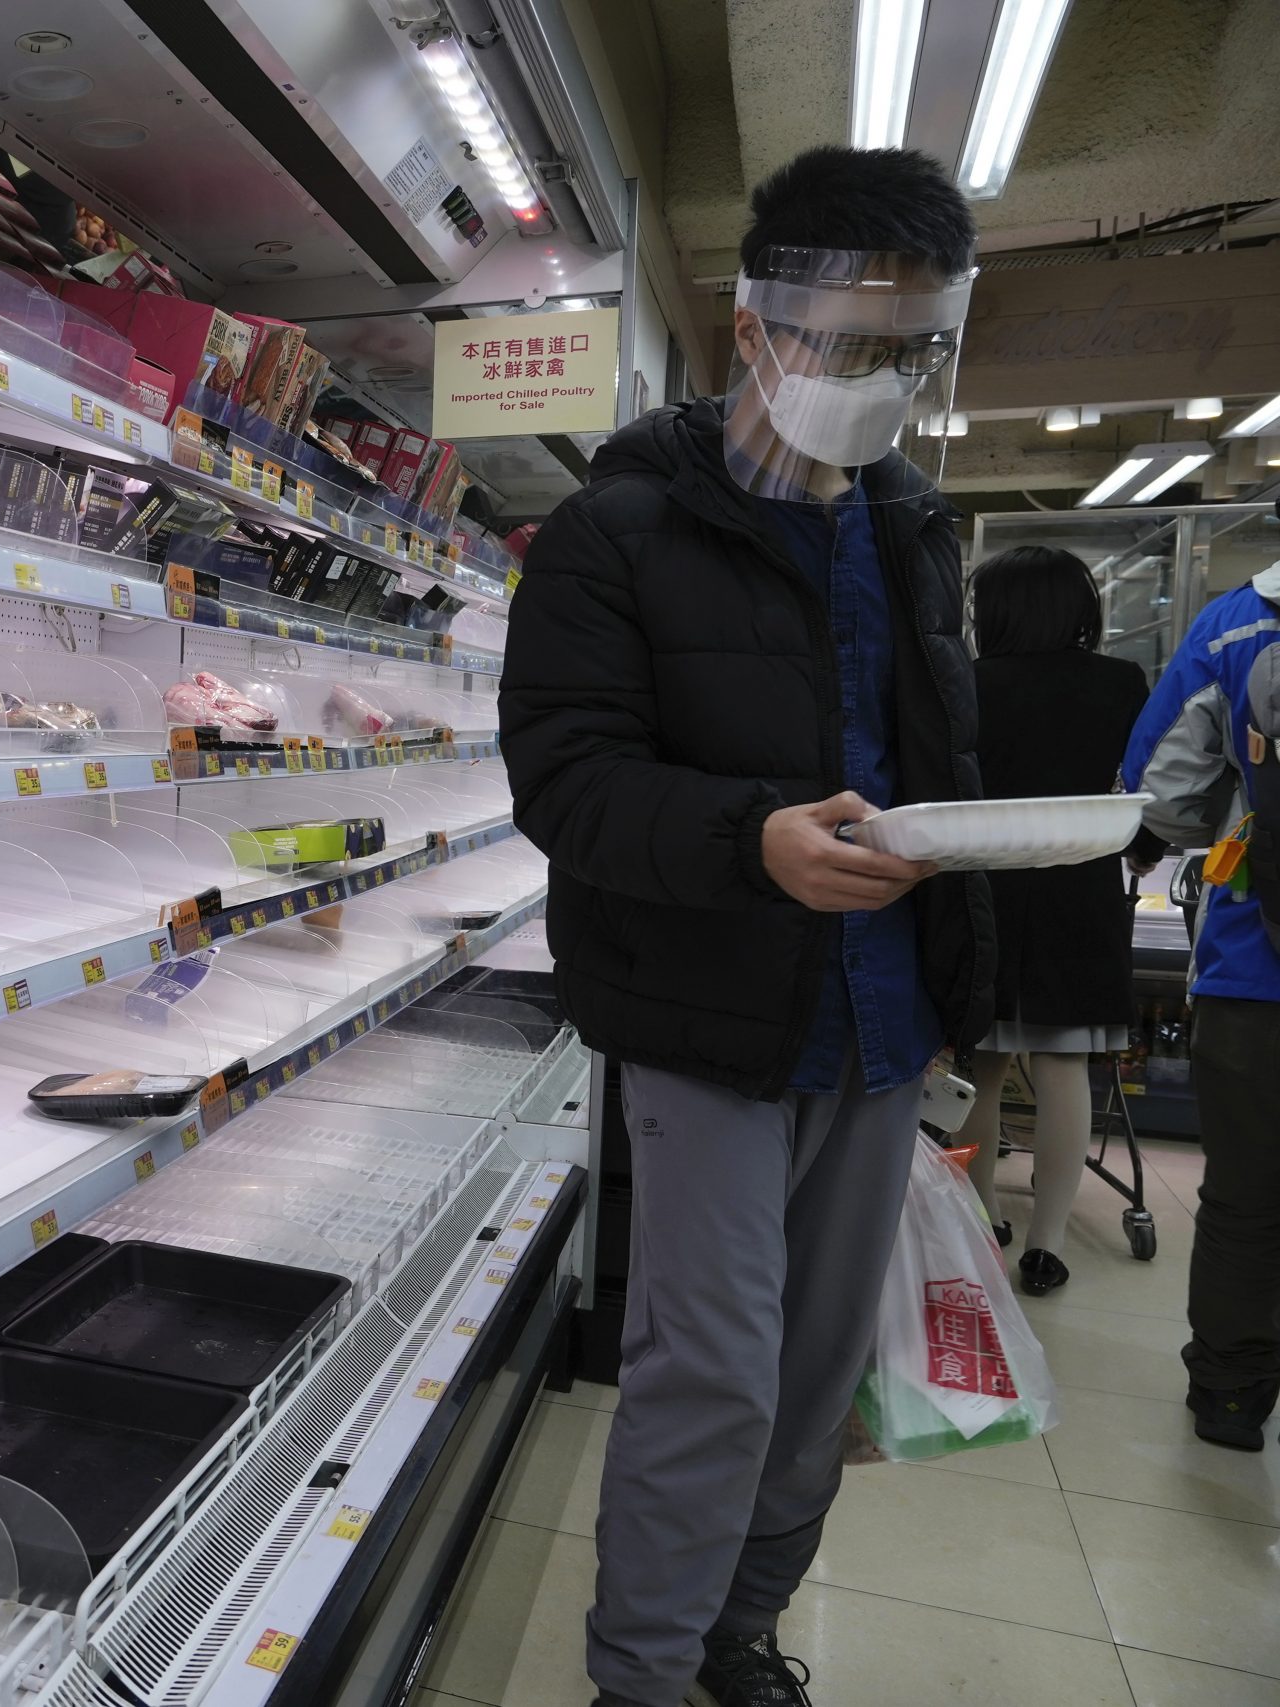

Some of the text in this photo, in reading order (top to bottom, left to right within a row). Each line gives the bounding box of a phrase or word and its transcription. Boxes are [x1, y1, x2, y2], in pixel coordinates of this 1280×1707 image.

[462, 334, 589, 360] 本店有售進口
[482, 358, 566, 380] 冰鮮家禽
[451, 386, 595, 403] Imported Chilled Poultry
[500, 400, 544, 411] for Sale
